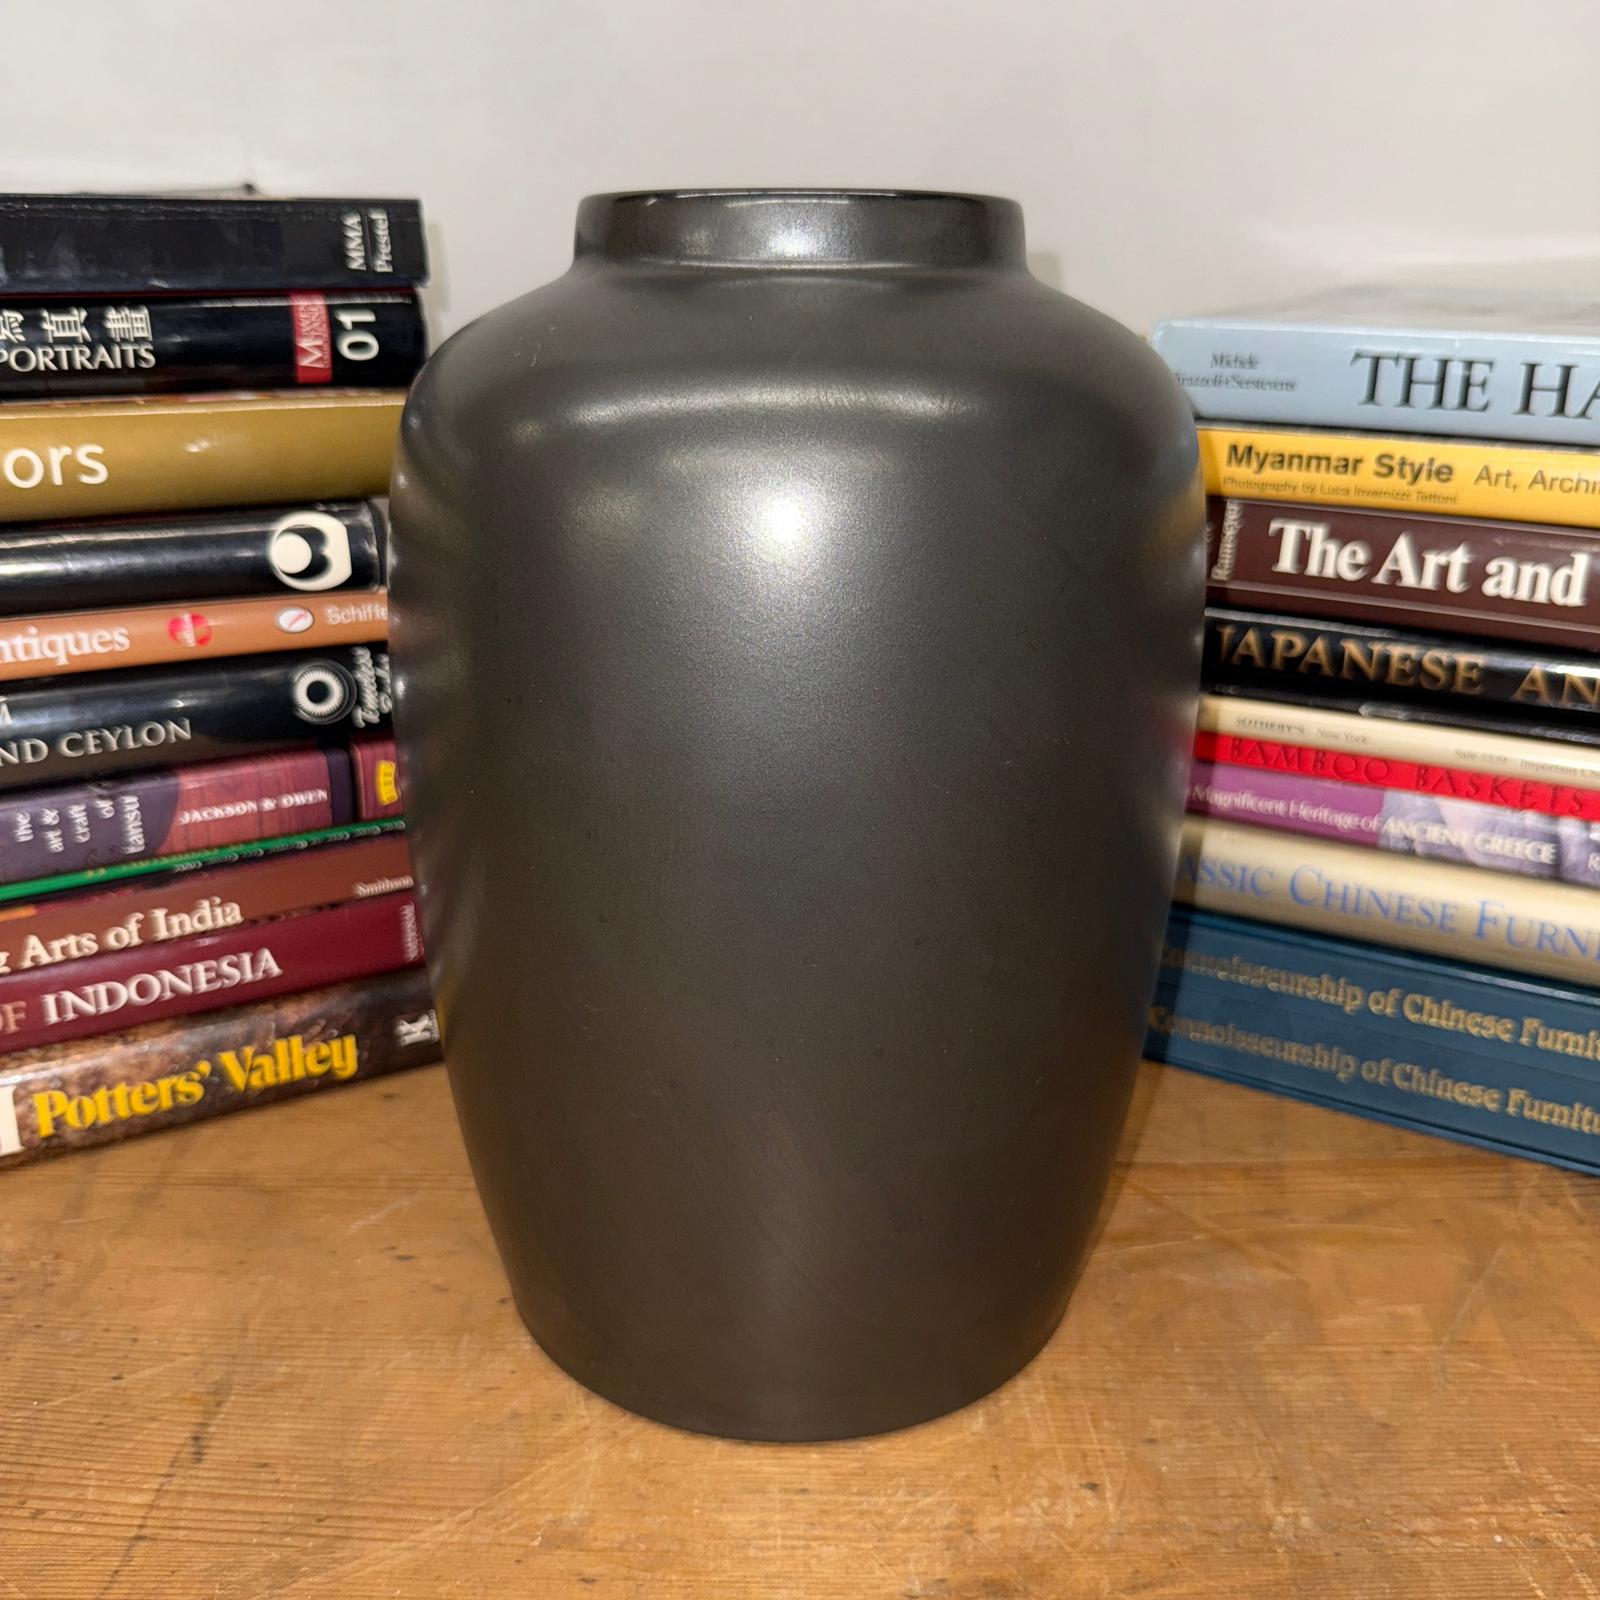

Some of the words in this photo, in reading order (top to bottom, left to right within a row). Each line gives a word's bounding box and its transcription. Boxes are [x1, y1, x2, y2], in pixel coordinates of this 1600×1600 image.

[334, 308, 379, 361] 01
[1350, 347, 1495, 414] THE
[3, 442, 109, 489] ors
[1222, 476, 1298, 495] Photography
[1301, 481, 1316, 496] by
[1319, 480, 1351, 497] Luca
[1354, 485, 1412, 501] Invernizzi
[1226, 443, 1364, 477] Myanmar
[1374, 452, 1454, 486] Style
[1473, 464, 1518, 494] Art,
[1268, 517, 1371, 582] The
[1371, 530, 1474, 593] Art
[1481, 551, 1592, 607] and
[1215, 622, 1487, 696] JAPANESE
[57, 716, 192, 758] CEYLON
[1228, 737, 1391, 784] BAMBOO
[1414, 765, 1586, 816] BASKETS
[12, 811, 35, 843] the
[40, 807, 60, 826] &
[67, 803, 91, 843] craft
[94, 798, 115, 819] of
[1192, 784, 1288, 819] Magnificent
[1288, 800, 1360, 834] Heritage
[1360, 811, 1381, 833] of
[1381, 816, 1471, 849] ANCIENT
[1473, 833, 1557, 865] GREECE
[42, 828, 64, 853] art
[1288, 864, 1459, 933] CHINESE
[21, 933, 98, 970] Arts
[100, 913, 144, 951] of
[151, 896, 244, 941] India
[0, 1000, 27, 1035] F
[40, 947, 284, 1027] INDONESIA
[1368, 987, 1402, 1017] of
[1402, 993, 1515, 1043] Chinese
[1519, 1016, 1600, 1061] Furni
[33, 1057, 212, 1138] Potters'
[217, 1033, 358, 1095] Valley
[1360, 1057, 1392, 1087] of
[1392, 1062, 1502, 1113] Chinese
